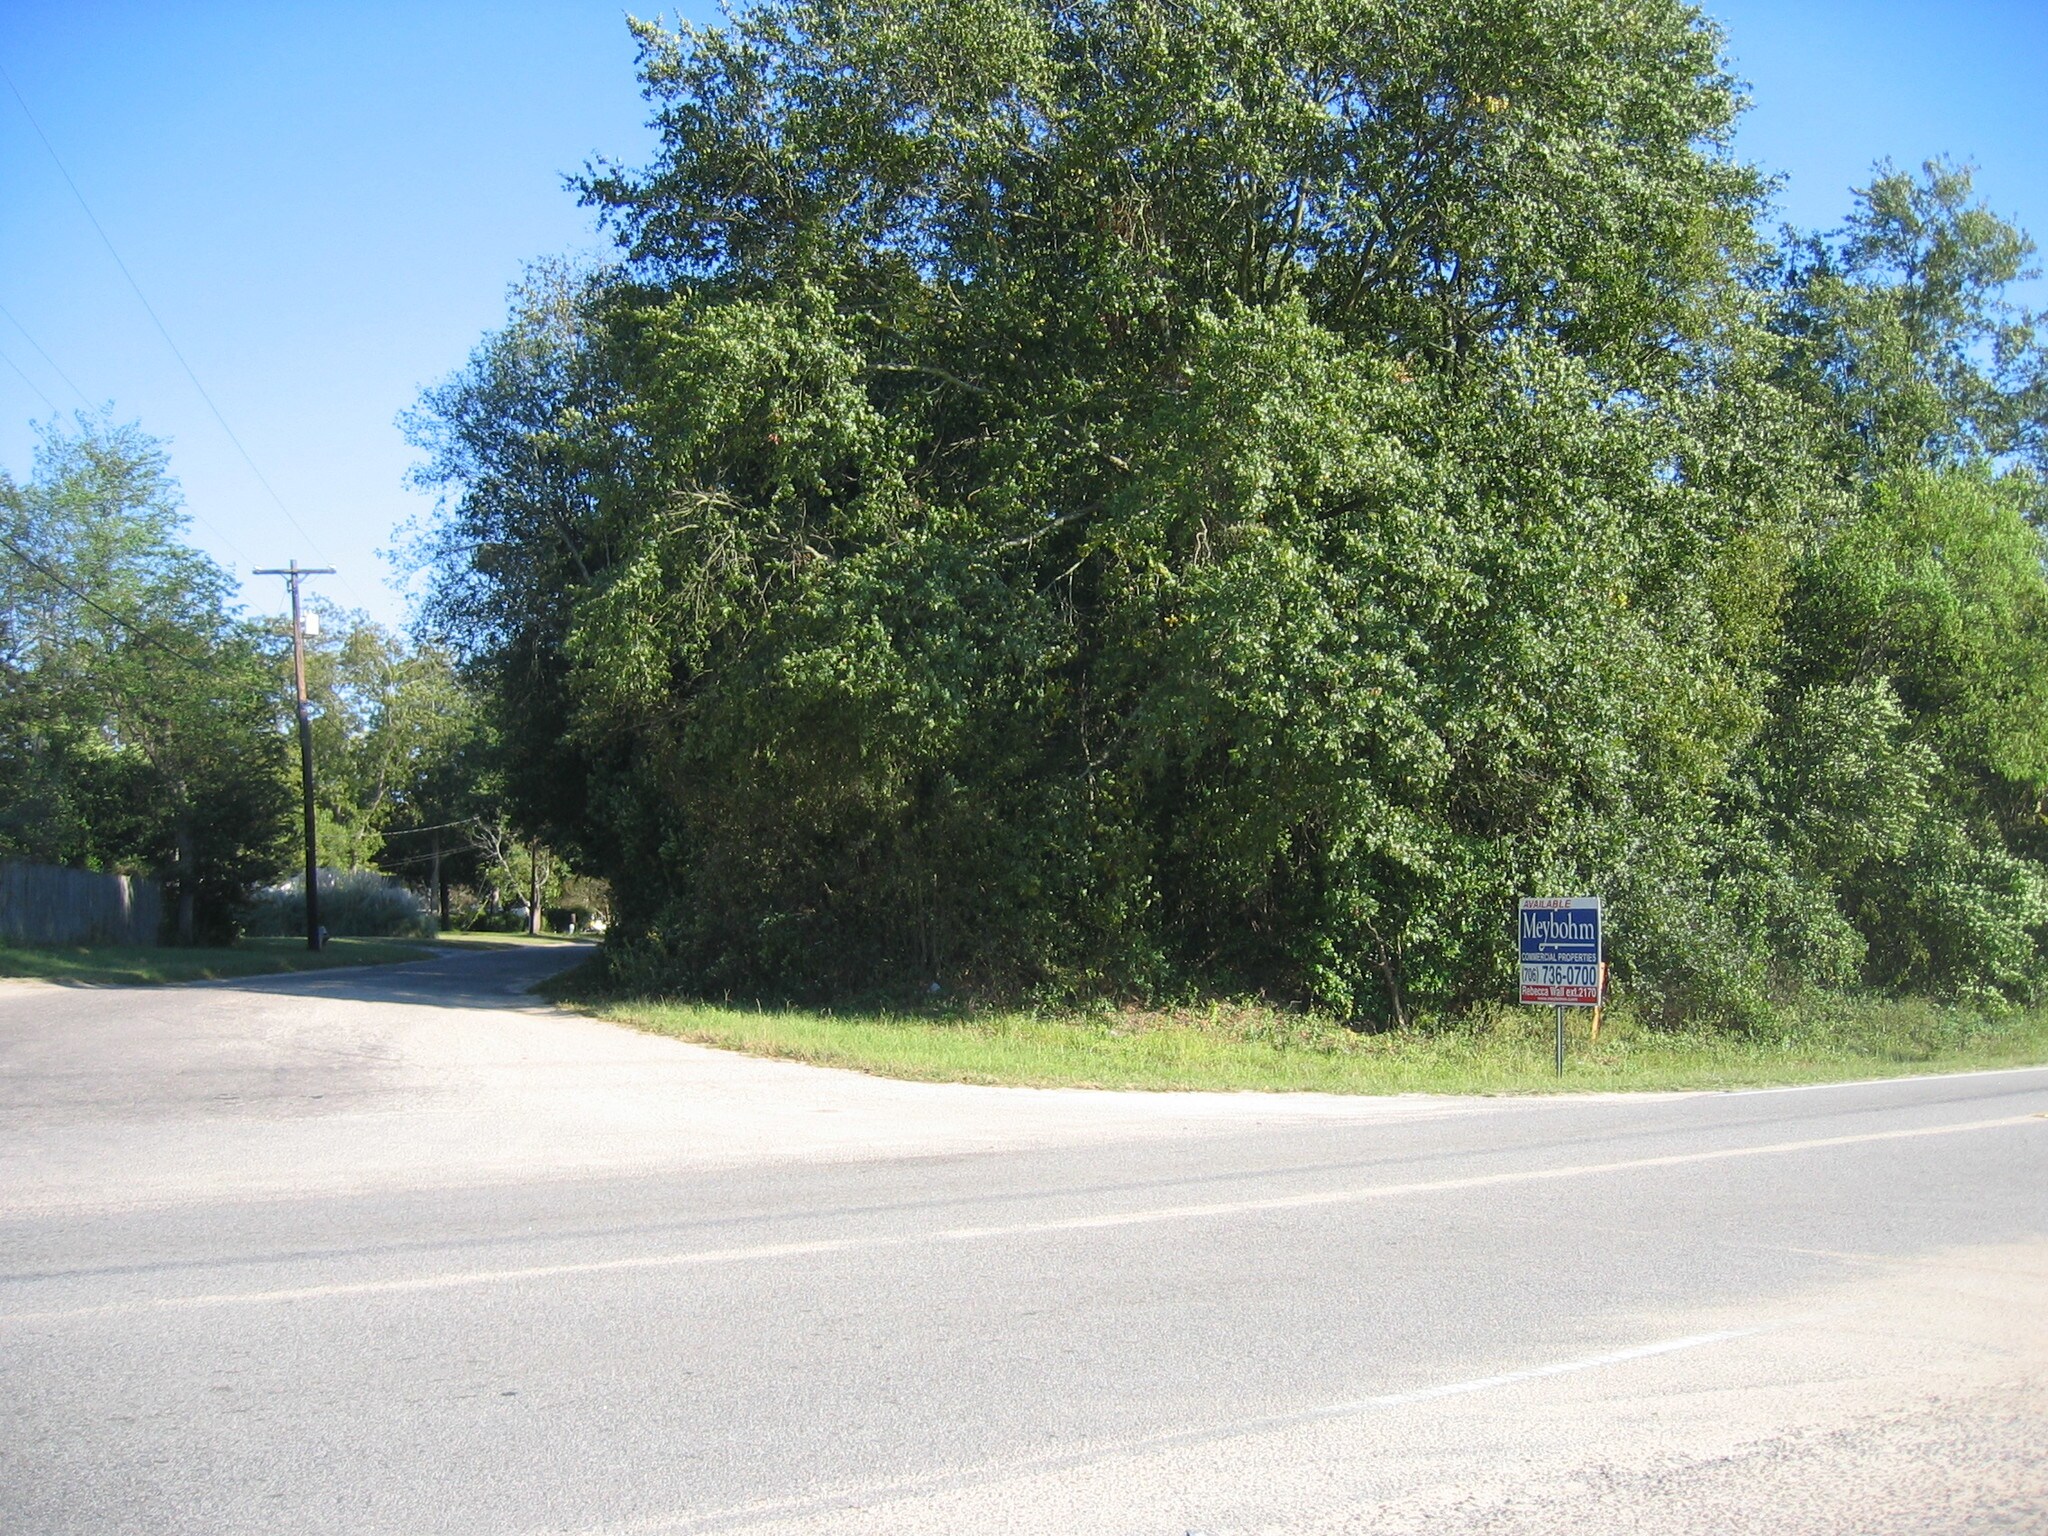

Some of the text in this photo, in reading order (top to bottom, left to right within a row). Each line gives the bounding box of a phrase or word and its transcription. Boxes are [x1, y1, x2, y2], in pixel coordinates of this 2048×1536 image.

[1523, 900, 1571, 908] AVAILABLE
[1523, 911, 1595, 945] Meybohm
[1522, 952, 1596, 962] COMMERCIAL PROPERTIES
[1522, 966, 1596, 985] (706) 736-0700
[1522, 986, 1549, 996] Rebecca
